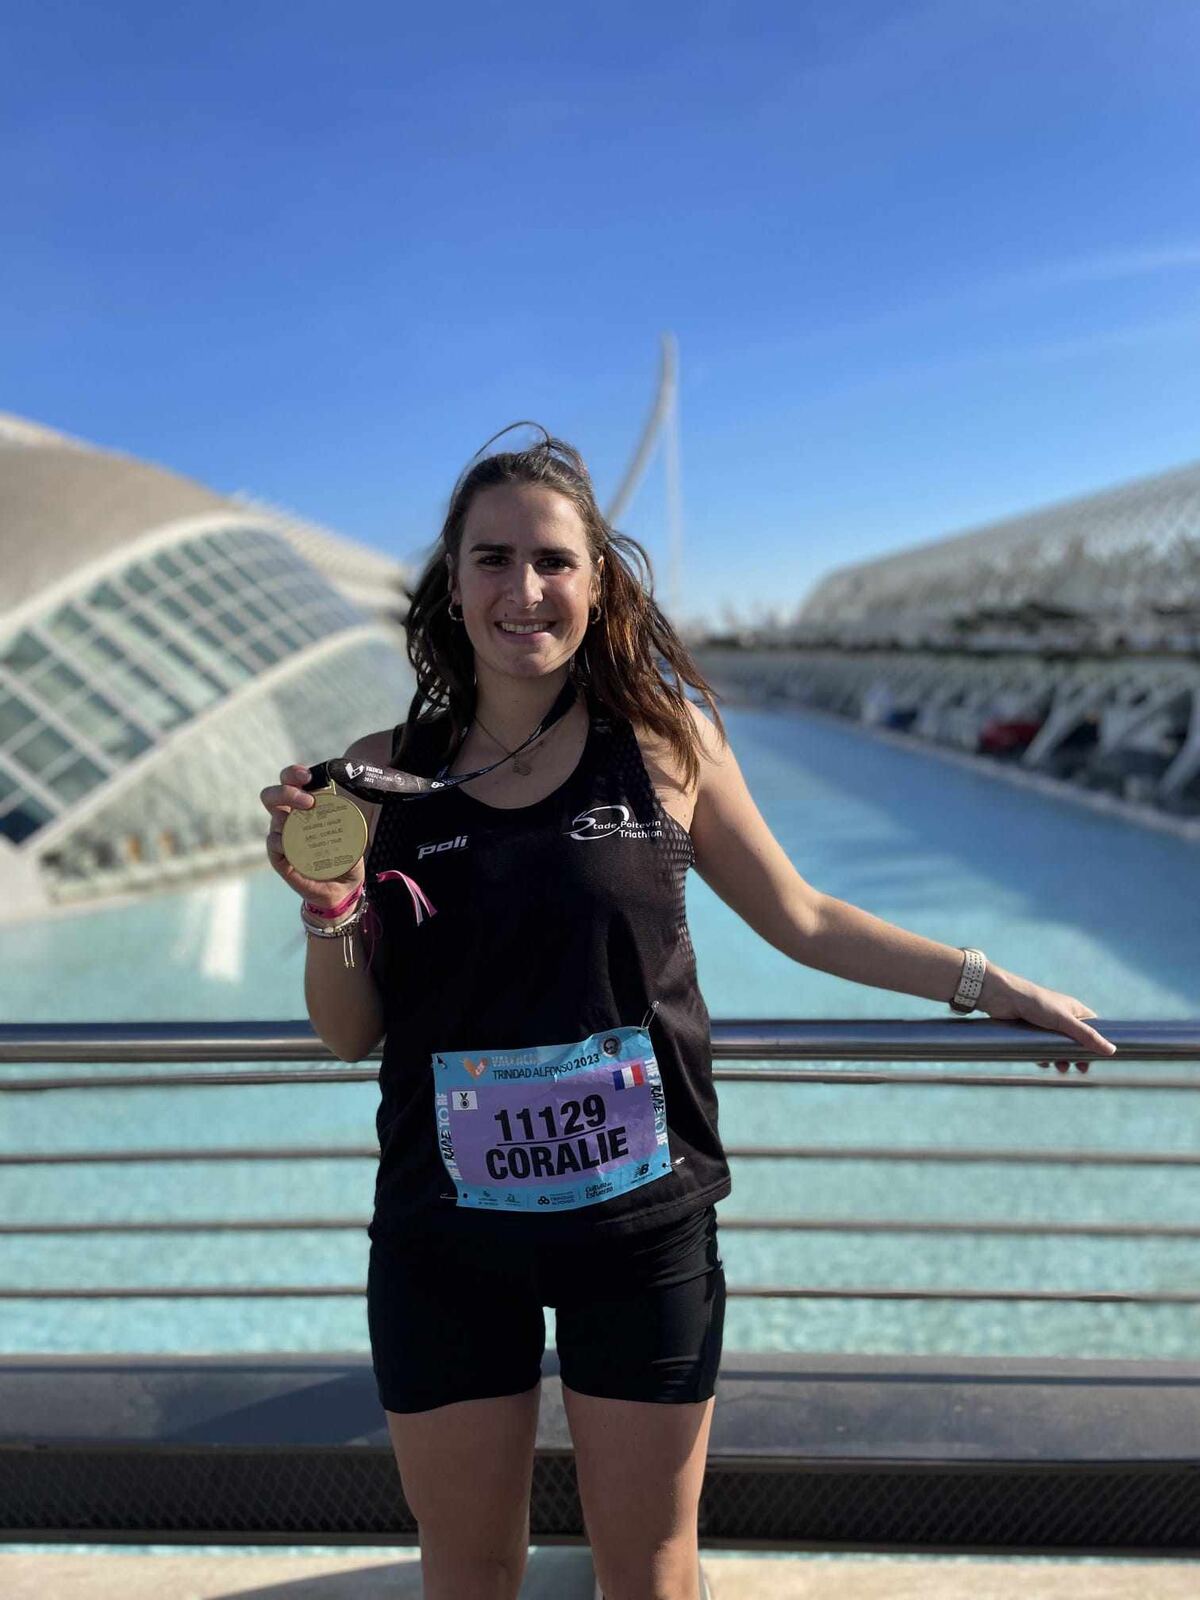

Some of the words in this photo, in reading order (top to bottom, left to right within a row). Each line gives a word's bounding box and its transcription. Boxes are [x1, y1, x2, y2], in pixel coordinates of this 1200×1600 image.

[417, 835, 469, 860] poli
[619, 829, 663, 839] Triathlon
[492, 1068, 532, 1081] TRINIDAD
[532, 1061, 574, 1078] ALFONSO
[574, 1053, 601, 1069] 2023
[494, 1094, 607, 1141] 11129
[485, 1126, 630, 1180] CORALIE
